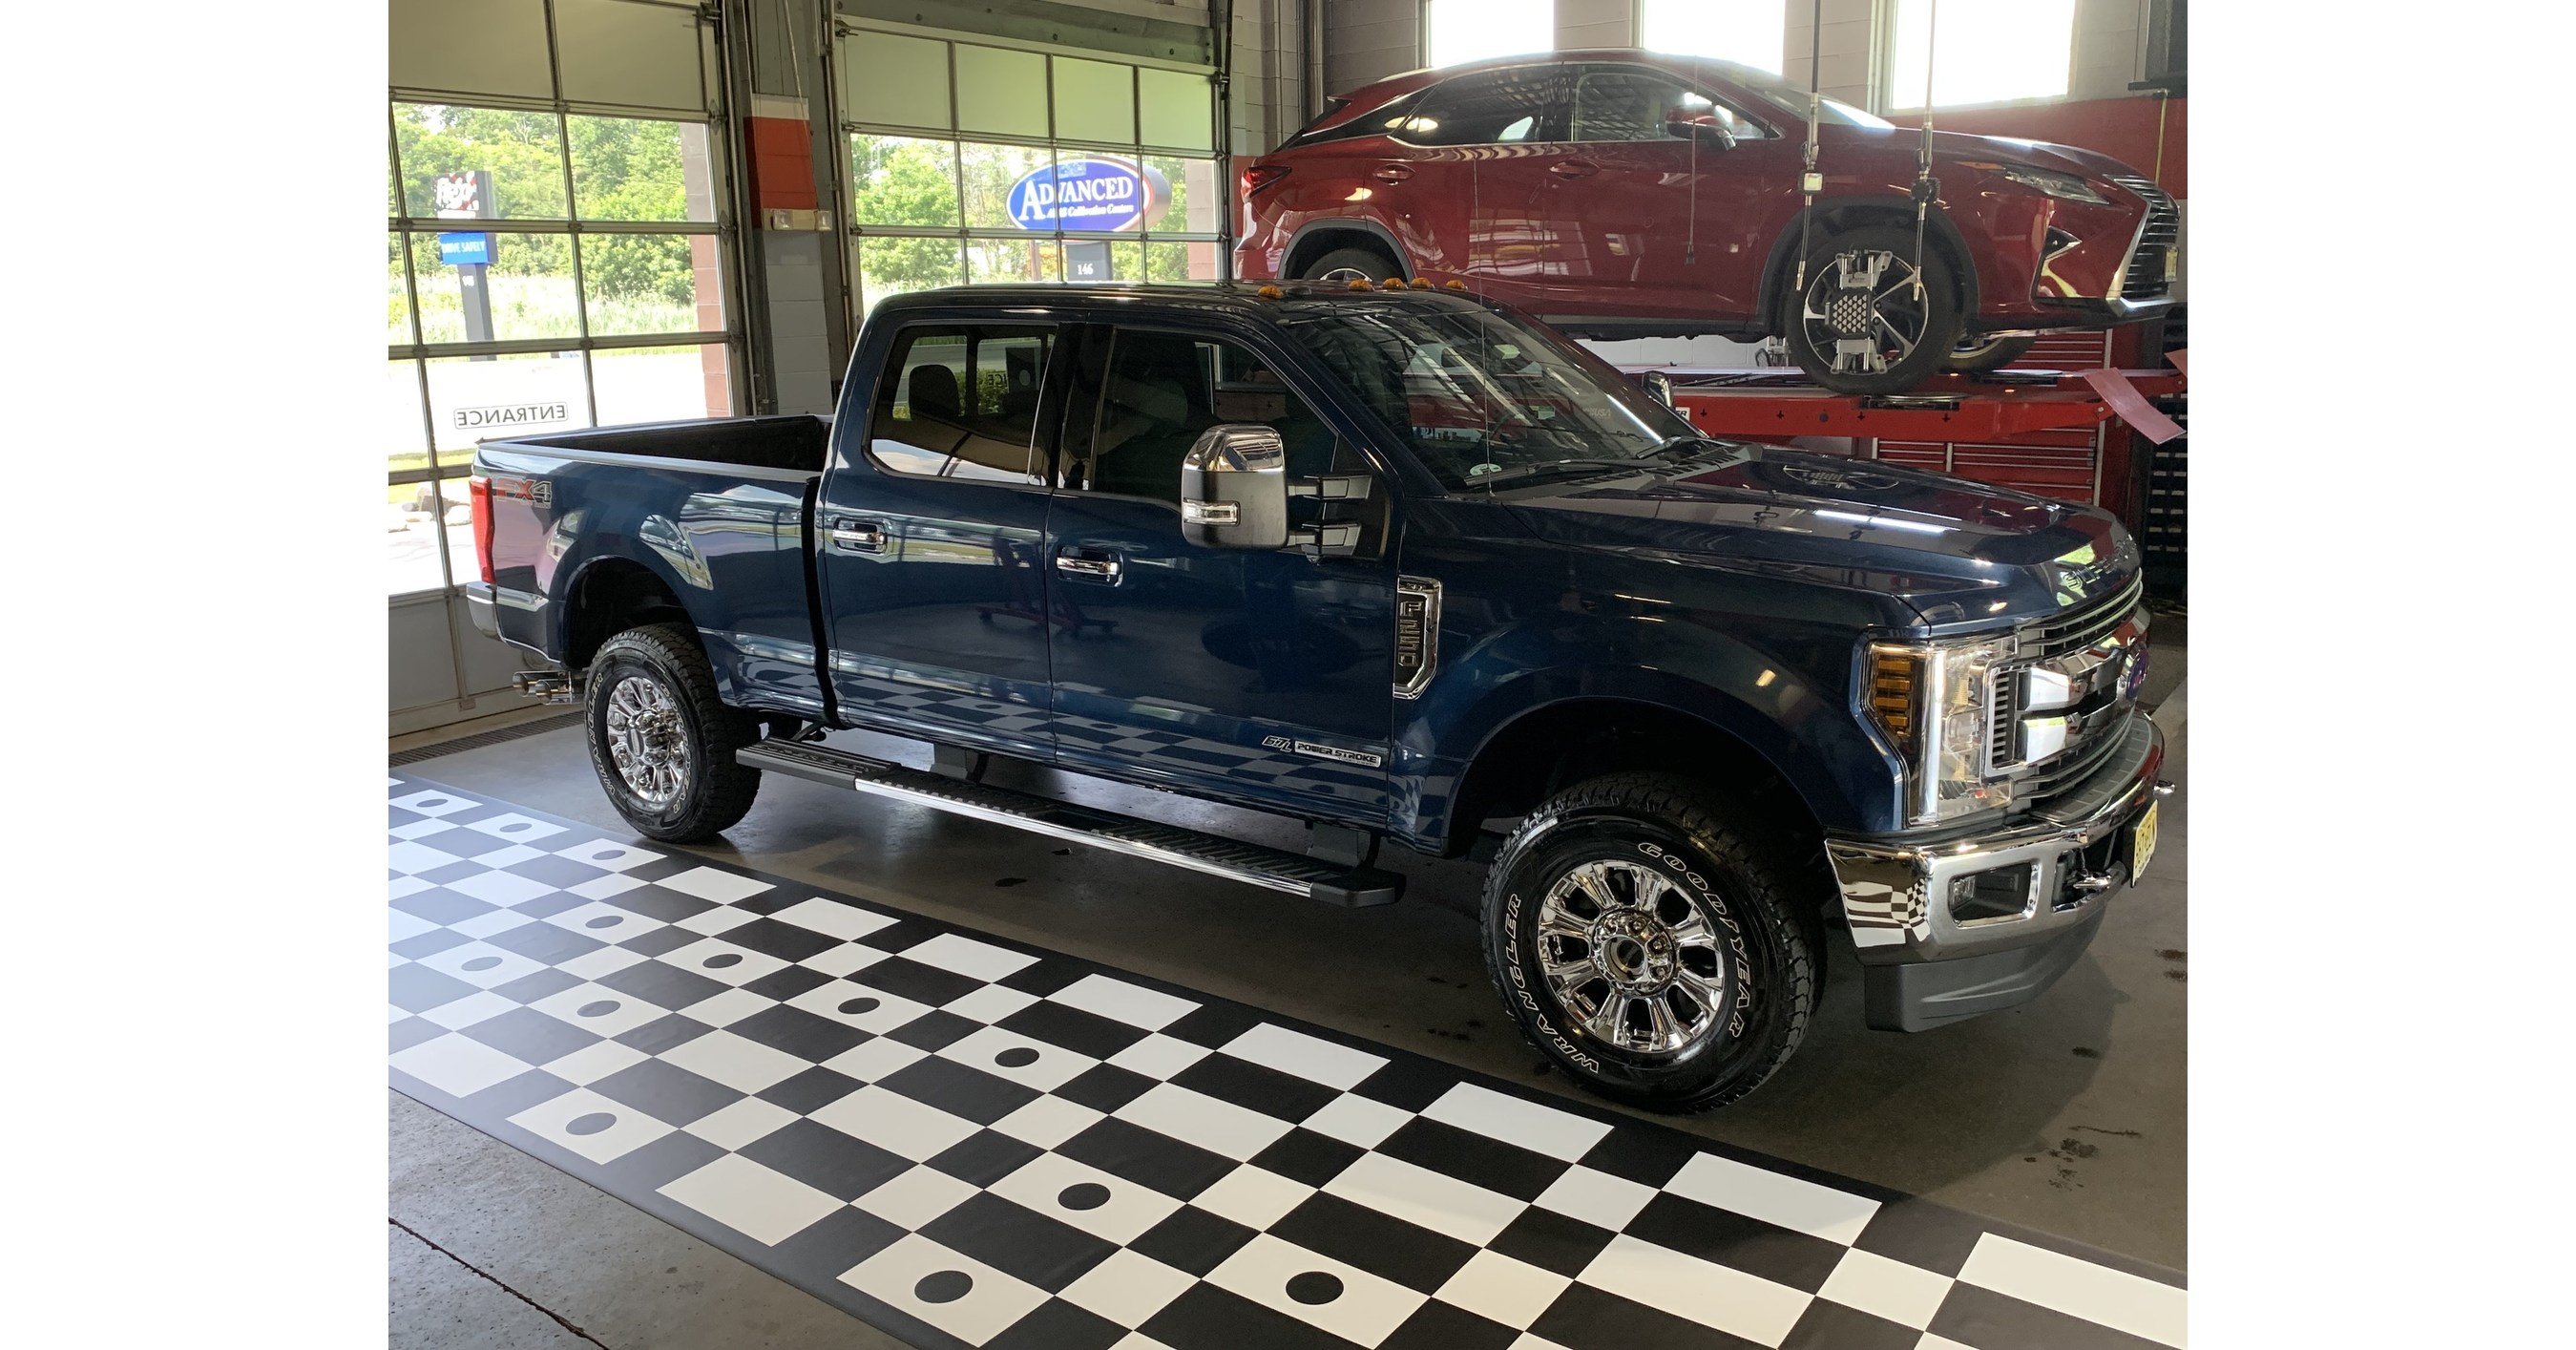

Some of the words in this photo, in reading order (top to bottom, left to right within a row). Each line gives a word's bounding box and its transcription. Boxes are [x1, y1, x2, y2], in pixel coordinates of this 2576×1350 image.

[1017, 177, 1134, 221] ADVANCED
[461, 241, 486, 253] SAFELY
[1077, 263, 1094, 275] 146
[496, 476, 552, 503] FX4
[587, 672, 616, 795] WRANGLER
[660, 683, 690, 814] GOODYEAR
[1296, 742, 1333, 757] POWER
[1335, 749, 1378, 764] STROKE
[1638, 842, 1751, 1038] GOODYEAR
[1505, 893, 1600, 1074] WRANGLER
